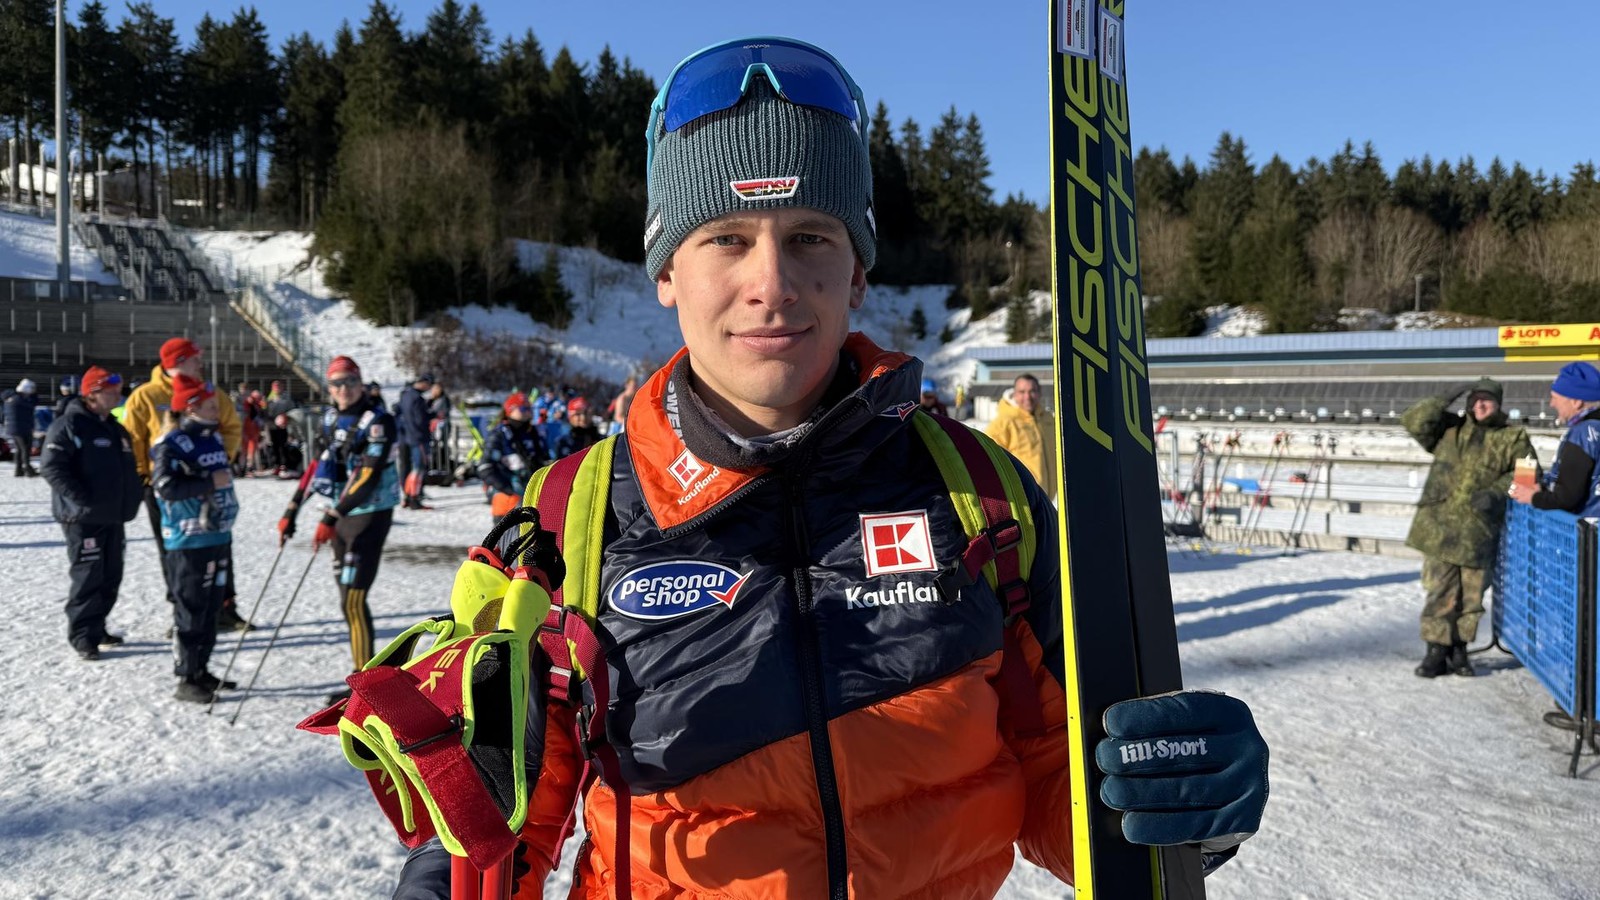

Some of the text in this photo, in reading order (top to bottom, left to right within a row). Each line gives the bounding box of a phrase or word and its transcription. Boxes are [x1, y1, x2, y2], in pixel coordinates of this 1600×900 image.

[1100, 0, 1154, 455] FISCHE
[1519, 329, 1560, 338] LOTTO
[677, 466, 720, 506] Kaufland
[620, 571, 725, 600] personal
[642, 586, 701, 608] shop
[845, 581, 961, 610] Kaufla
